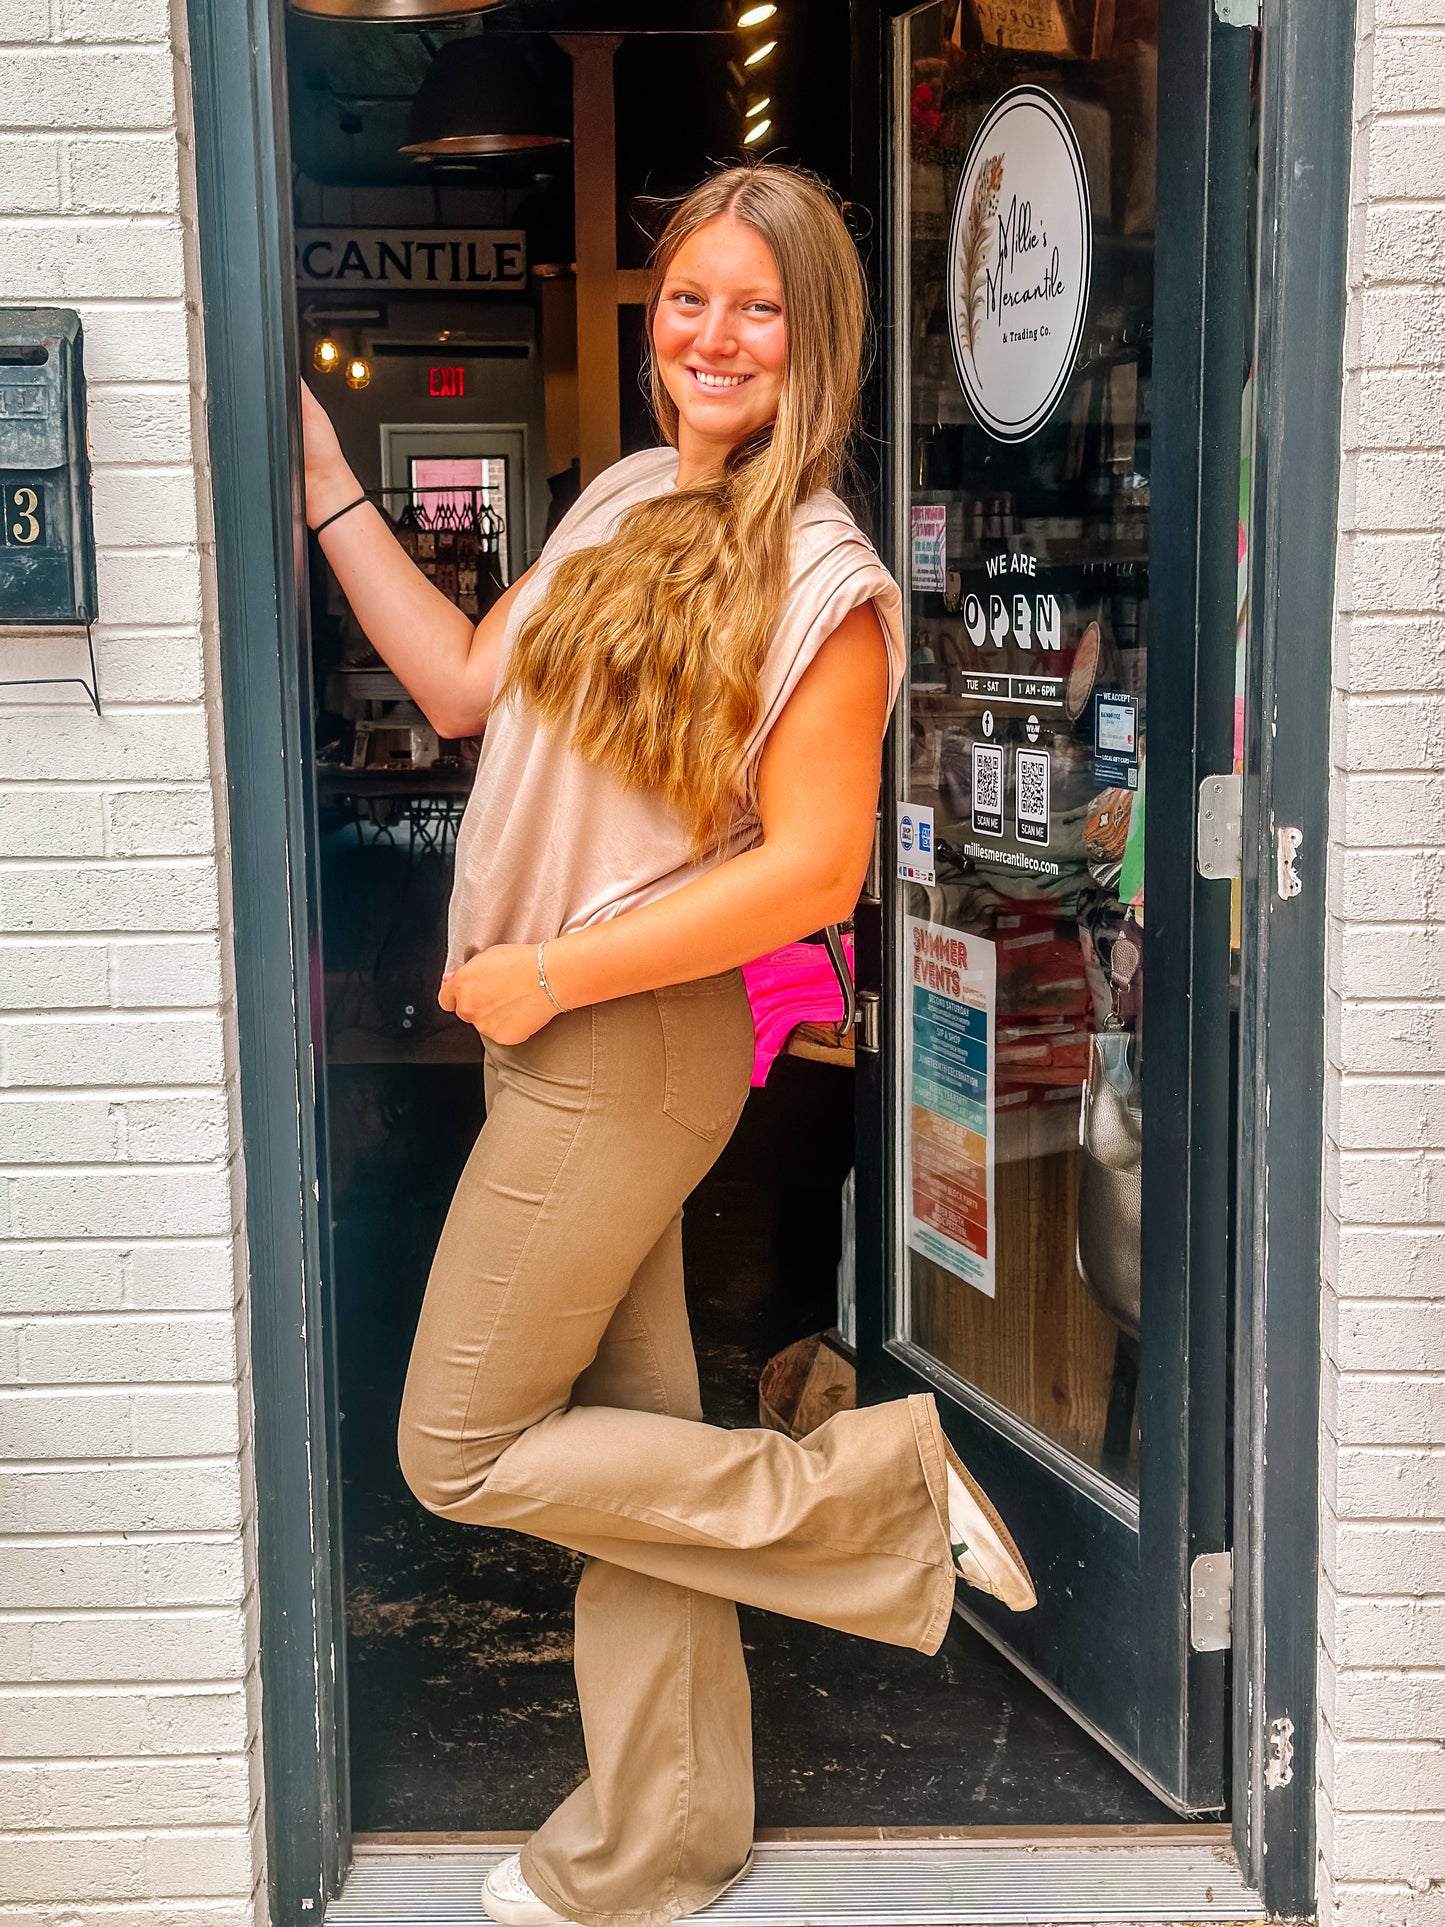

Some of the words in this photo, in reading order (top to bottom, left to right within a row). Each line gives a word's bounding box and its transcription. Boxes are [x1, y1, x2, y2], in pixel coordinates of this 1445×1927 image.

[998, 194, 1047, 274] Millie's
[295, 241, 523, 282] CANTILE
[986, 246, 1065, 327] Mercantile
[1003, 333, 1008, 343] &
[1010, 328, 1038, 342] Trading
[1040, 325, 1051, 336] Co.
[429, 367, 465, 396] EXIT
[13, 488, 40, 543] 3
[986, 554, 1007, 578] WE
[1010, 553, 1037, 577] ARE
[964, 594, 1061, 650] OPEN
[966, 680, 979, 690] TUE
[1103, 692, 1111, 701] WE
[1112, 693, 1131, 702] ACCEPT
[977, 815, 990, 827] SCAN
[990, 818, 999, 829] ME
[1021, 823, 1035, 836] SCAN
[1035, 826, 1045, 838] ME
[964, 841, 1059, 875] milliesmercantileco.com
[913, 927, 968, 971] SUMMER
[914, 955, 961, 998] EVENTS
[928, 993, 945, 1008] SECOND
[945, 1001, 969, 1017] SATURDAY
